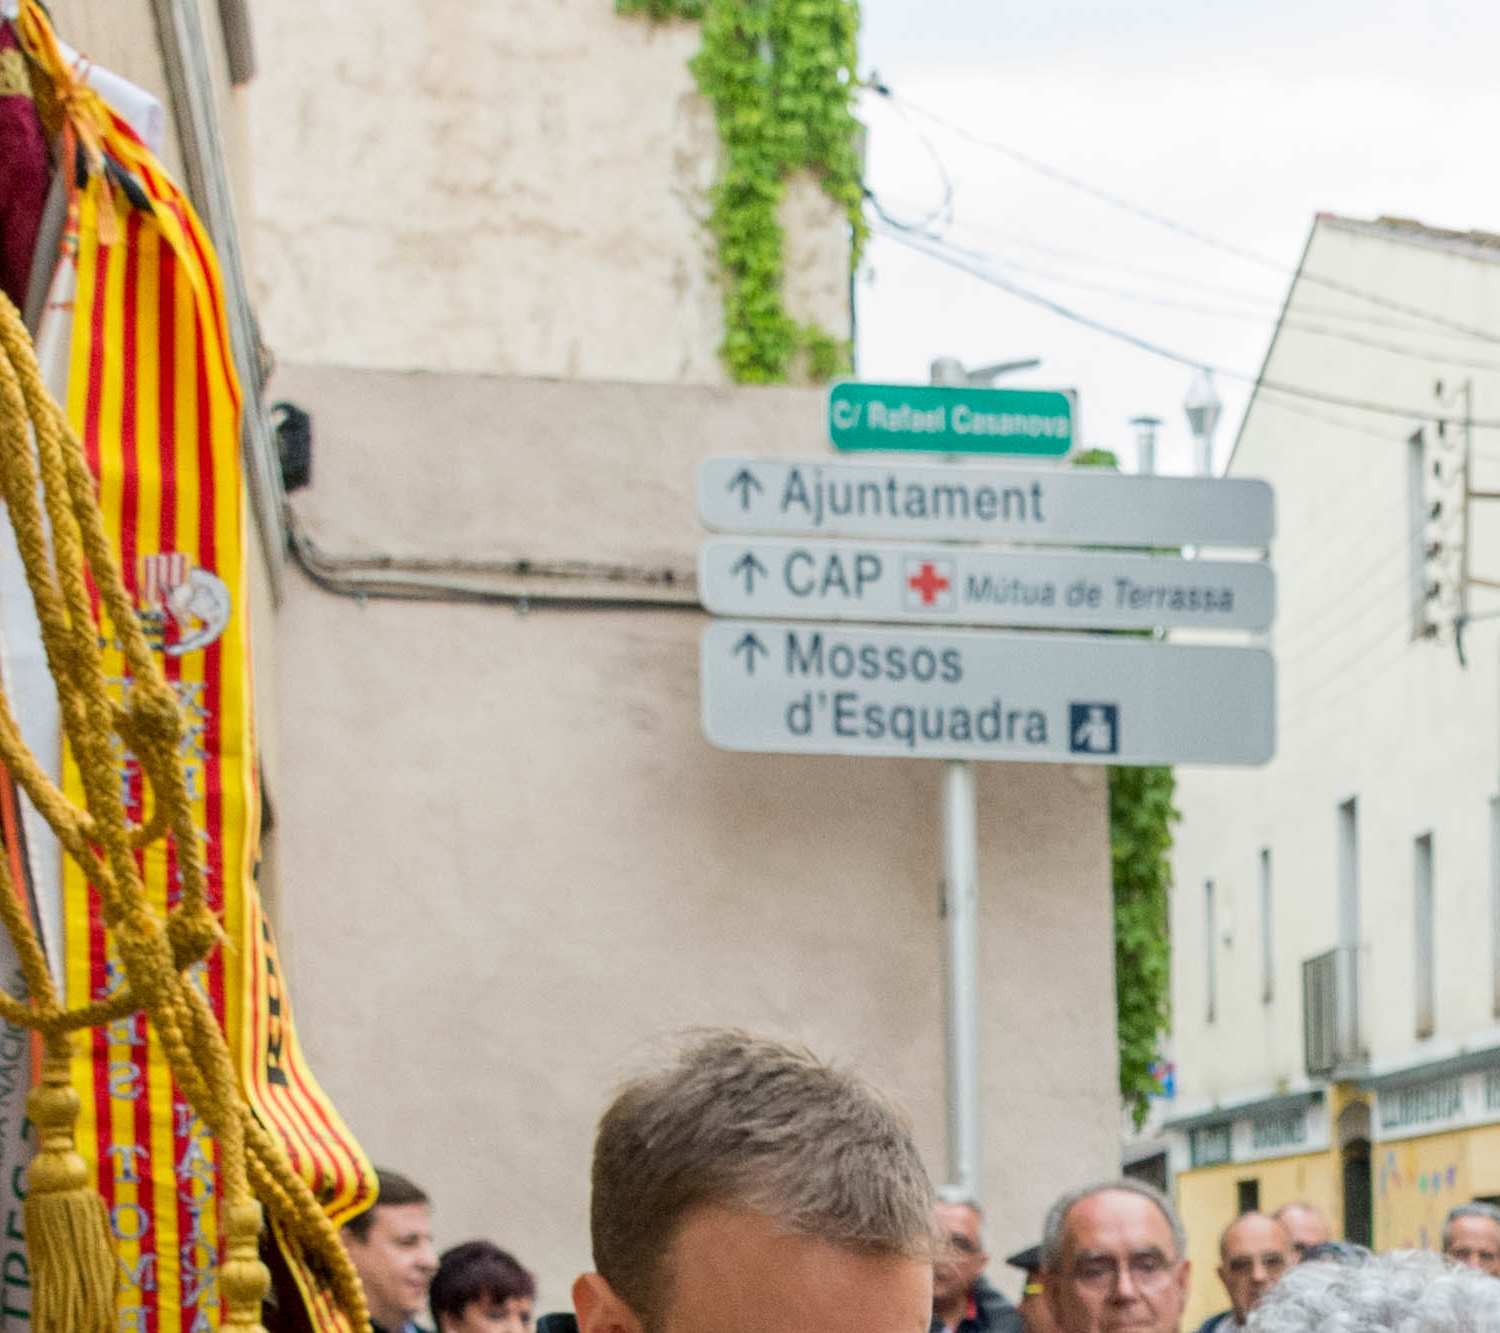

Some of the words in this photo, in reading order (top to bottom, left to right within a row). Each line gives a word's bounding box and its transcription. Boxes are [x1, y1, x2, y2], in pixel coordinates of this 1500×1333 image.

[833, 400, 863, 430] C/
[866, 401, 946, 433] Rafael
[951, 404, 1069, 438] Casanova
[780, 468, 1045, 526] Ajuntament
[783, 549, 882, 599] CAP
[1063, 578, 1102, 609] de
[1113, 575, 1235, 613] Terrassa
[785, 630, 964, 683] Mossos
[785, 690, 1049, 748] d'Esquadra
